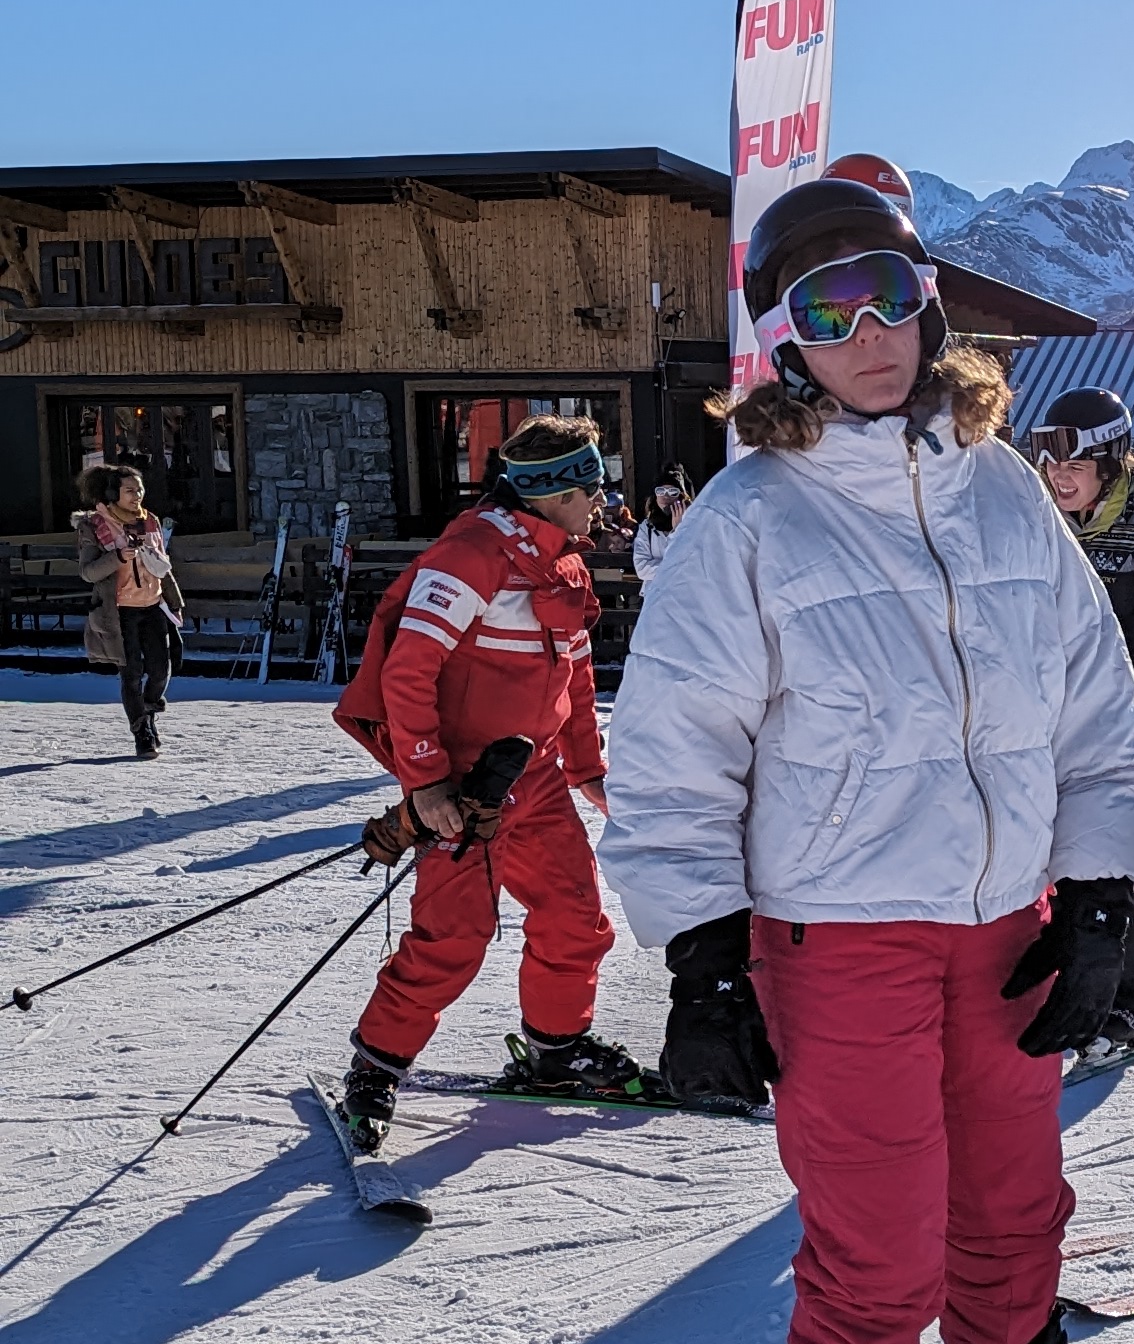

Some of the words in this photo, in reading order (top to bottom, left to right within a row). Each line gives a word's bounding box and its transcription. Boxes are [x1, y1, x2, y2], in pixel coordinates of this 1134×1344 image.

[796, 33, 824, 57] RAIO
[737, 101, 820, 176] FUN
[789, 152, 817, 171] ADIO
[39, 235, 288, 307] GUIDES
